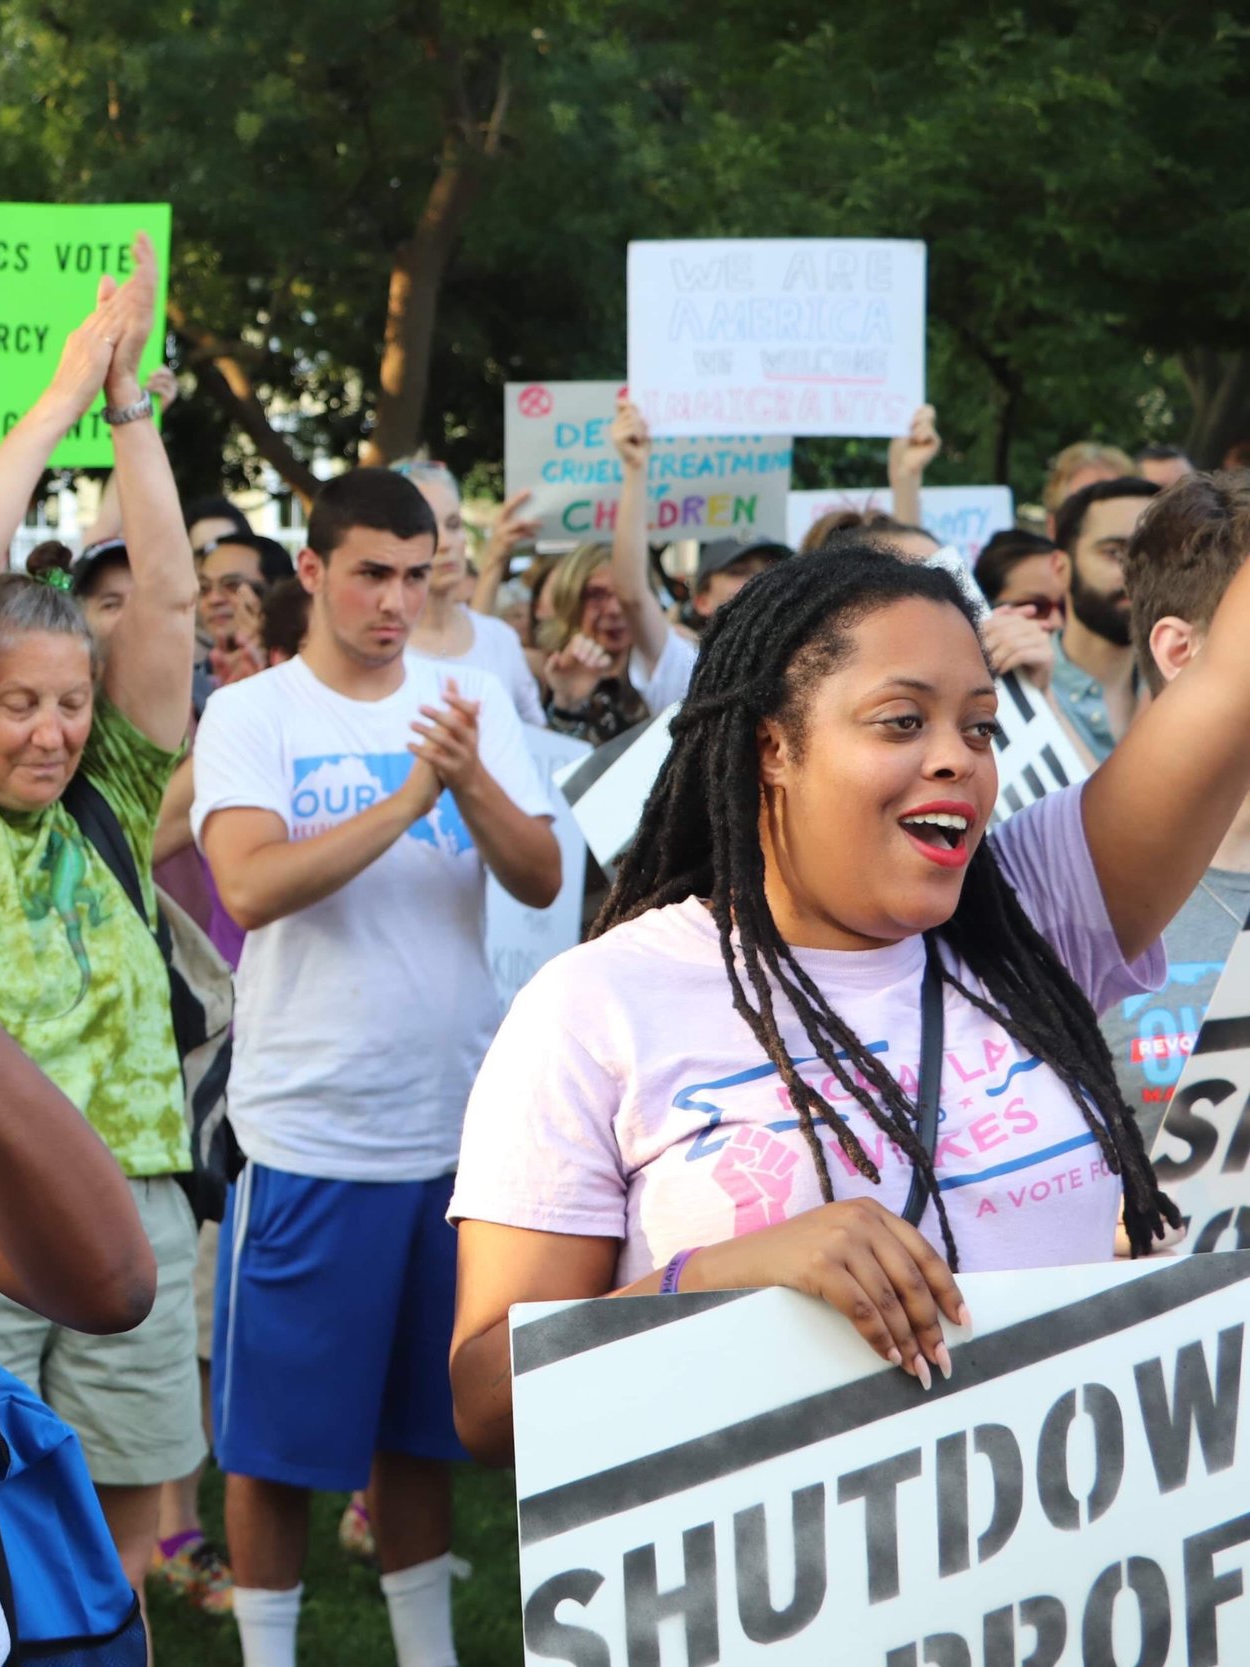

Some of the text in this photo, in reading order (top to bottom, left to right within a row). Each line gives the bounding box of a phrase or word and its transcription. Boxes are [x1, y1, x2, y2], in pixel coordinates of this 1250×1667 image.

[670, 249, 893, 293] WE ARE
[668, 297, 894, 344] AMERICA
[541, 458, 623, 484] CRUEL
[562, 494, 758, 532] CHDREN
[292, 785, 377, 818] OUR
[976, 1198, 998, 1218] A
[1007, 1167, 1084, 1208] VOTE
